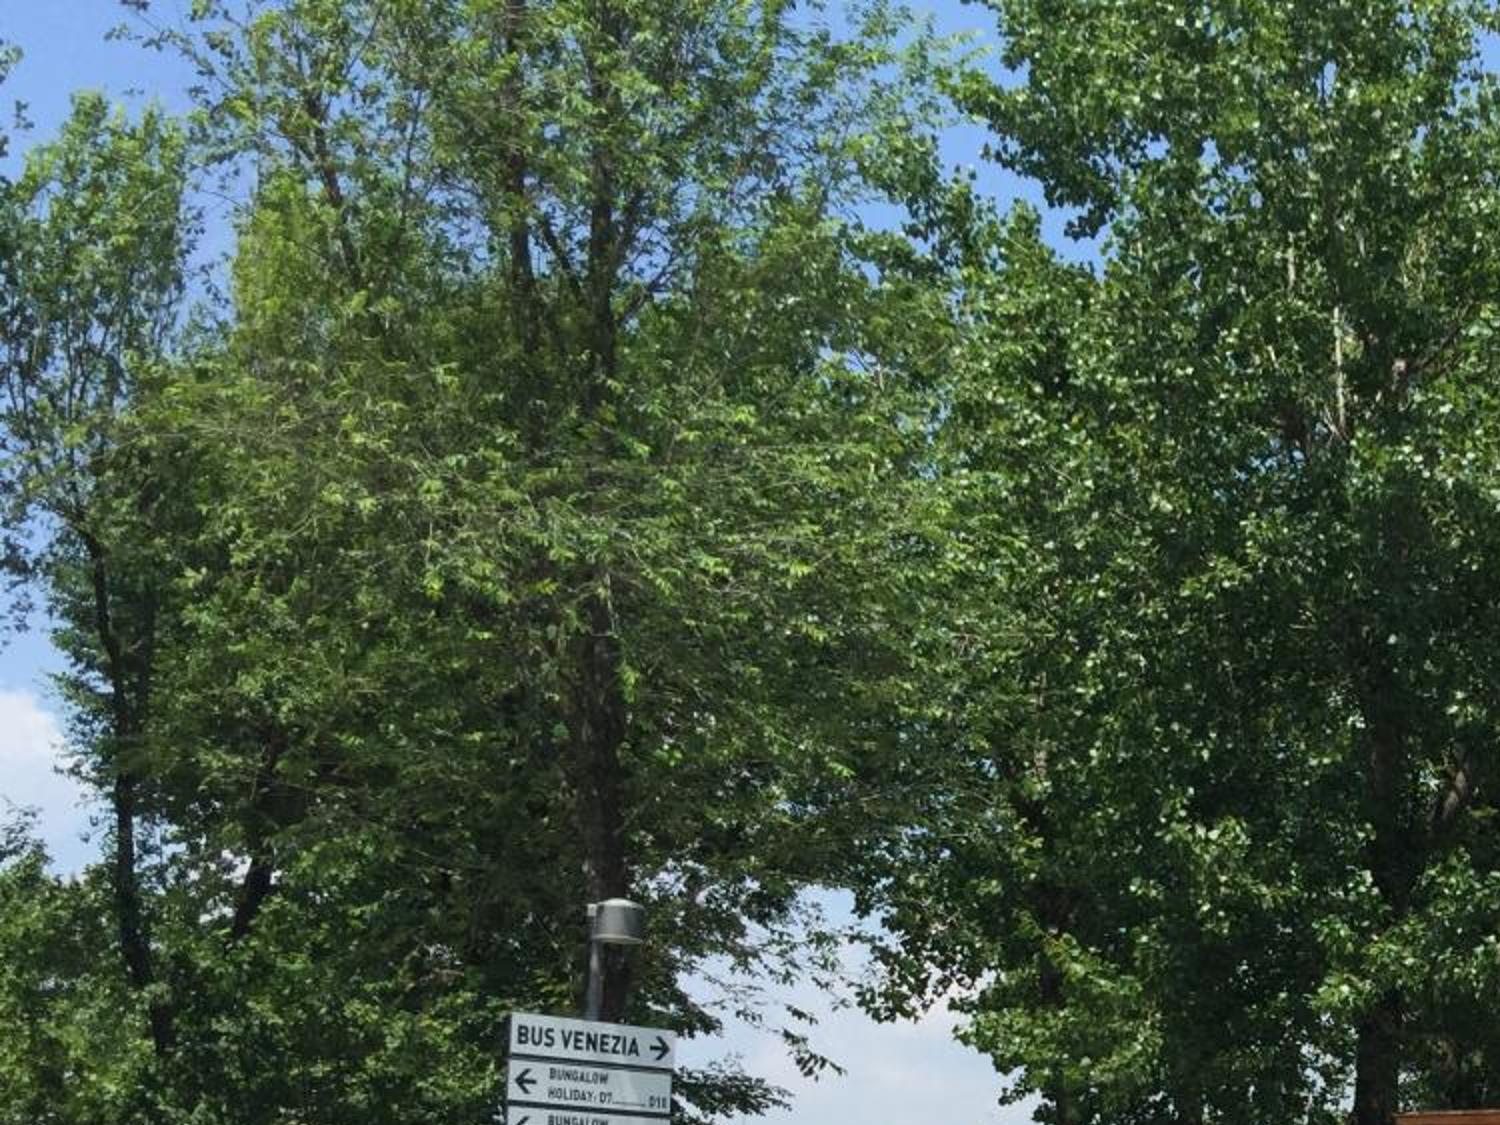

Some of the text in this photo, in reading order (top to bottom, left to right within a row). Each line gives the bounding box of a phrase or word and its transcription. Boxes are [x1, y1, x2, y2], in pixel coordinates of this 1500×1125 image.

[517, 1024, 640, 1057] BUS VENEZIA
[549, 1067, 609, 1085] BUNGALOW
